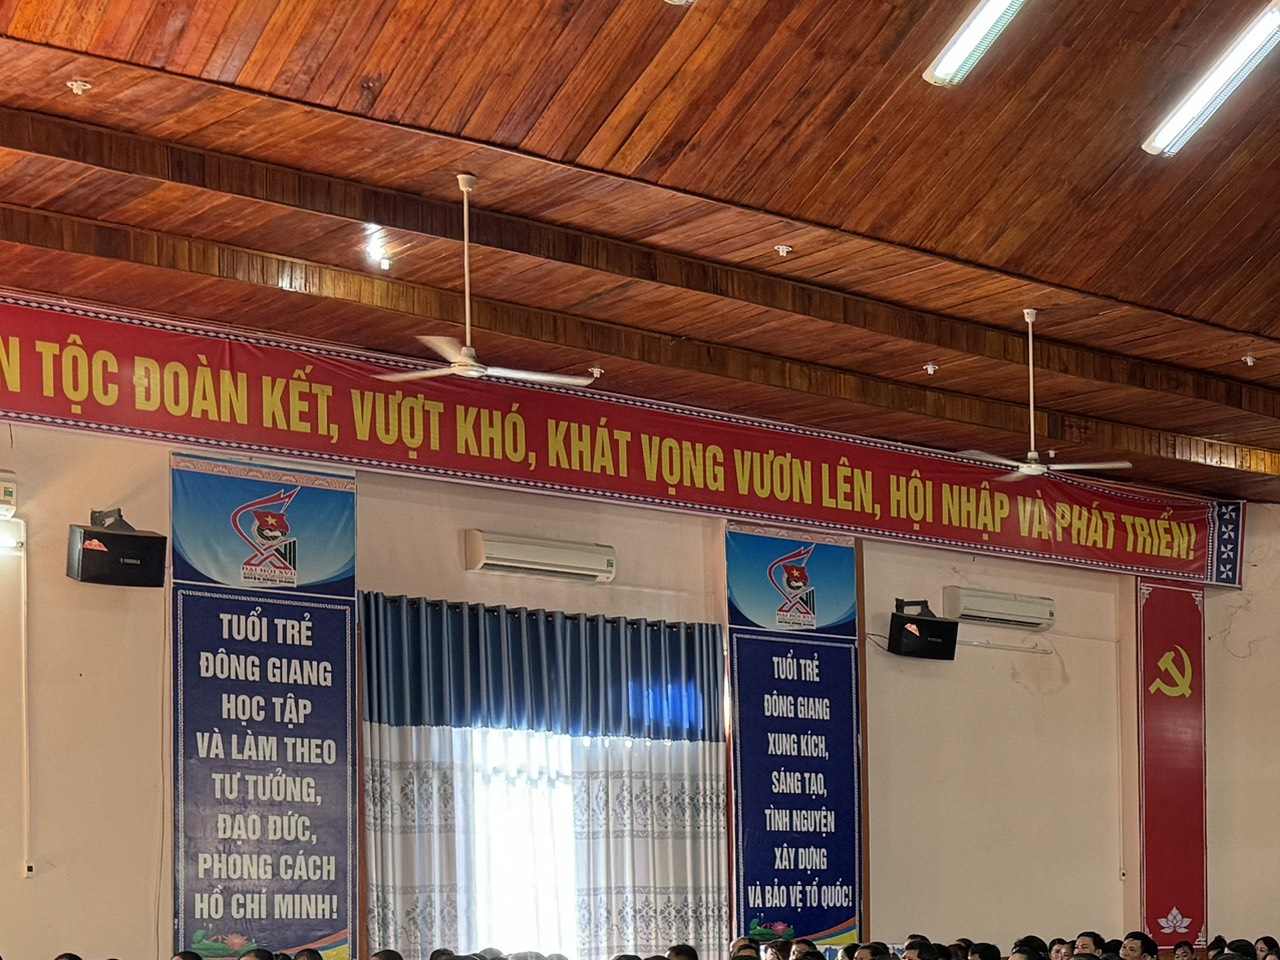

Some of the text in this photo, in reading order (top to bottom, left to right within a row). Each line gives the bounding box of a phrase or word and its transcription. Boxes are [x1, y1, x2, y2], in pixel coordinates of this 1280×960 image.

[35, 334, 119, 414] TỘC
[133, 354, 248, 425] ĐOÀN
[262, 365, 339, 444] KẾT,
[351, 389, 444, 460] VƯỢT
[456, 403, 537, 470] KHÓ,
[548, 417, 631, 478] KHÁT
[641, 433, 725, 495] VỌNG
[734, 448, 813, 505] VƯƠN
[821, 456, 881, 520] LÊN,
[890, 469, 933, 531] HỘI
[942, 480, 1010, 541] NHẬP
[1017, 489, 1050, 540] VÀ
[1055, 501, 1115, 550] PHÁT
[1121, 506, 1197, 560] TRIỂN!
[219, 606, 313, 646] TUỔI TRẺ
[199, 647, 332, 687] ĐÔNG GIANG
[772, 648, 820, 682] TUỔI TRẺ
[222, 692, 312, 729] HỌC TẬP
[763, 689, 831, 720] ĐÔNG GIANG
[196, 727, 337, 765] VÀ LÀM THEO
[767, 730, 829, 761] XUNG KÍCH,
[211, 767, 322, 806] TƯ TƯỞNG,
[771, 766, 828, 800] SÁNG TẠO,
[217, 810, 317, 845] ĐẠO ĐỨC,
[764, 803, 835, 838] TÌNH NGUYỆN
[198, 849, 336, 881] PHONG CÁCH
[774, 842, 828, 875] XÂY DỰNG
[194, 884, 338, 920] HỒ CHÍ MINH!
[747, 876, 853, 912] VÀ BẢO VỆ TỔ QUỐC!
